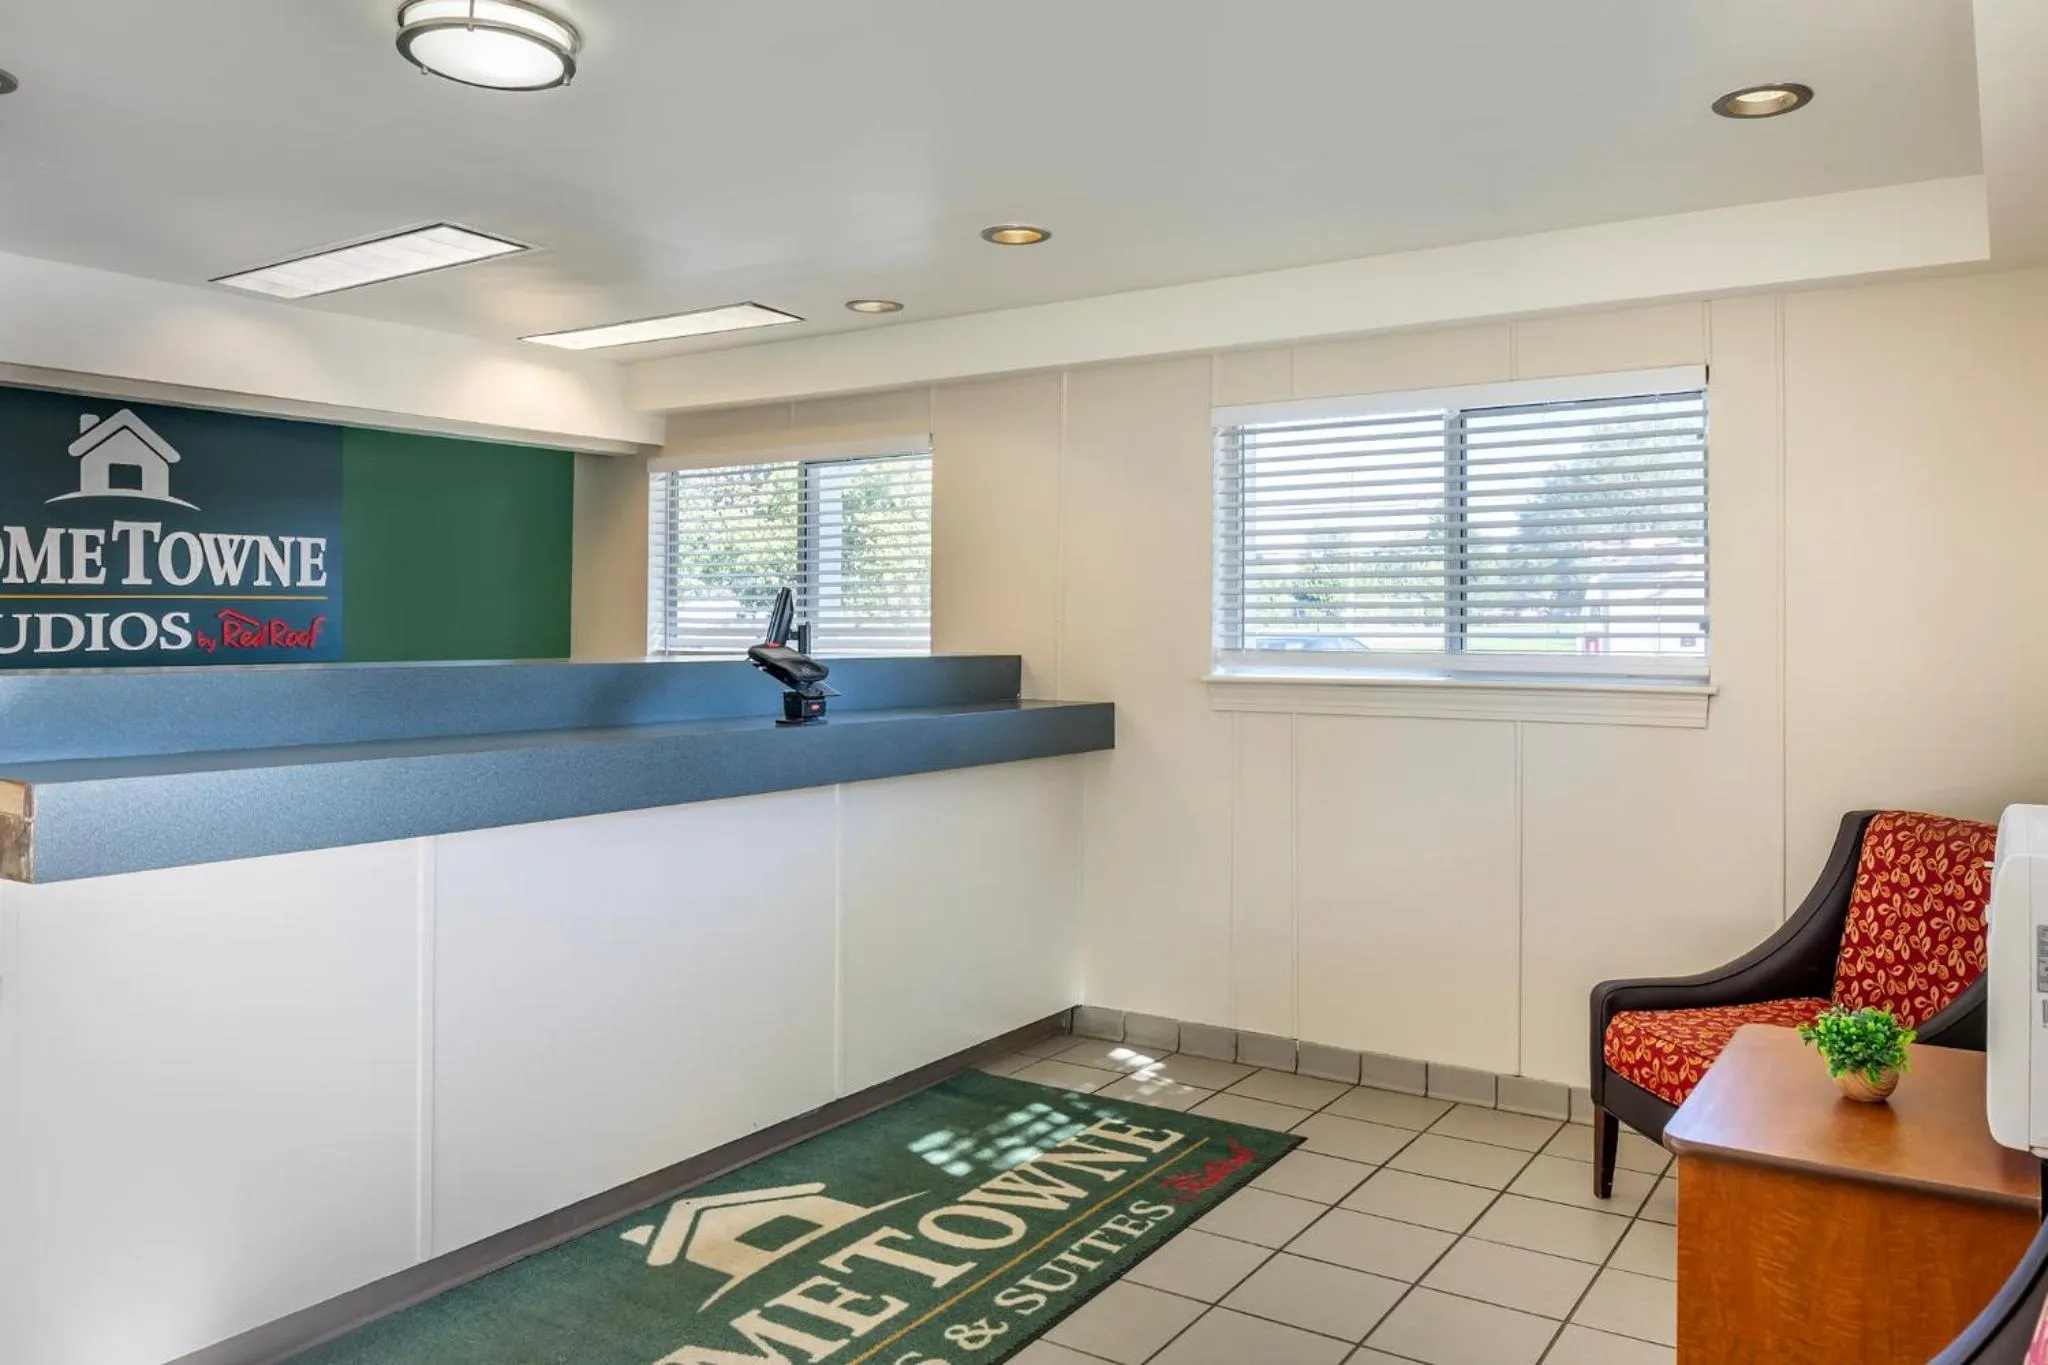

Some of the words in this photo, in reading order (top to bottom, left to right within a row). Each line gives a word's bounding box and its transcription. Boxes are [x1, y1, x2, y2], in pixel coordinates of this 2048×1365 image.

[0, 520, 327, 587] METOWNE
[197, 628, 217, 655] by
[944, 1317, 1009, 1350] &
[993, 1200, 1176, 1316] SUITES
